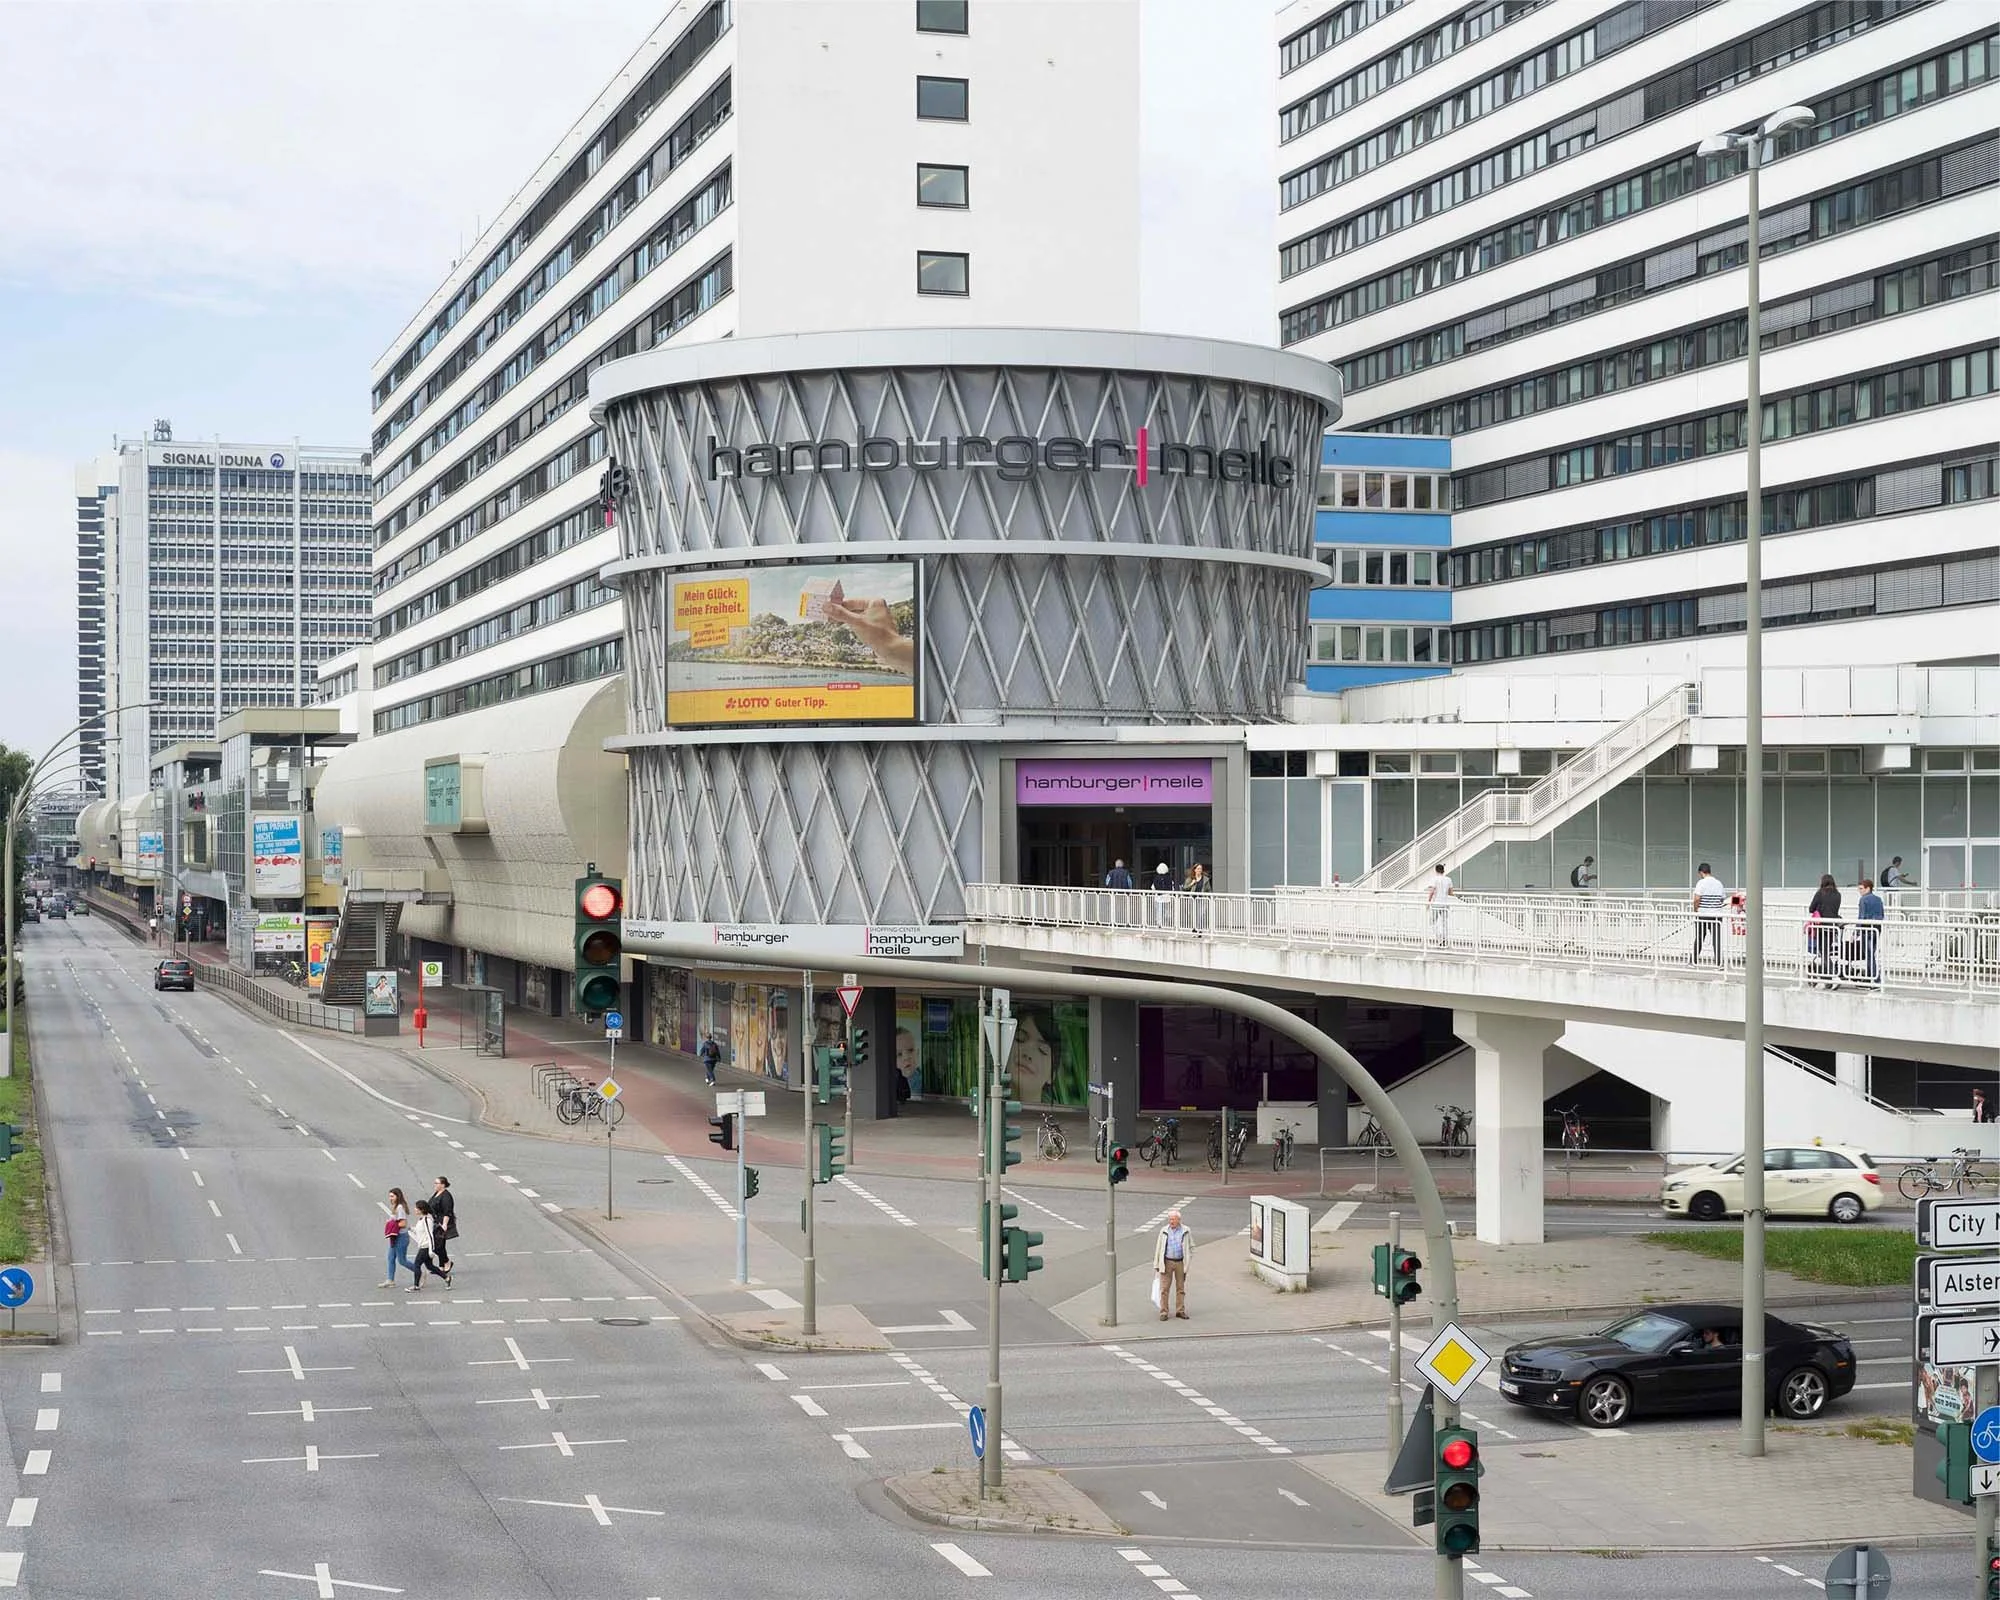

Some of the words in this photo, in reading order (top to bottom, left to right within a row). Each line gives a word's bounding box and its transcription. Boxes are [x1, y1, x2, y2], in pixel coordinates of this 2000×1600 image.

[162, 452, 215, 466] SIGNAL
[220, 455, 263, 467] IDUNA
[707, 425, 1126, 482] hamburger
[1159, 440, 1294, 489] meile
[684, 589, 705, 602] Mein
[707, 587, 738, 600] Glück:
[677, 605, 703, 617] meine
[705, 602, 745, 614] Freiheit.
[737, 697, 770, 708] LOTTO
[775, 698, 801, 709] Guter
[803, 696, 828, 709] Tipp.
[1025, 776, 1141, 791] hamburger
[1150, 776, 1204, 788] meile
[717, 931, 789, 945] hamburger
[869, 933, 960, 946] hamburger
[869, 944, 911, 955] meile
[1948, 1214, 1985, 1236] City
